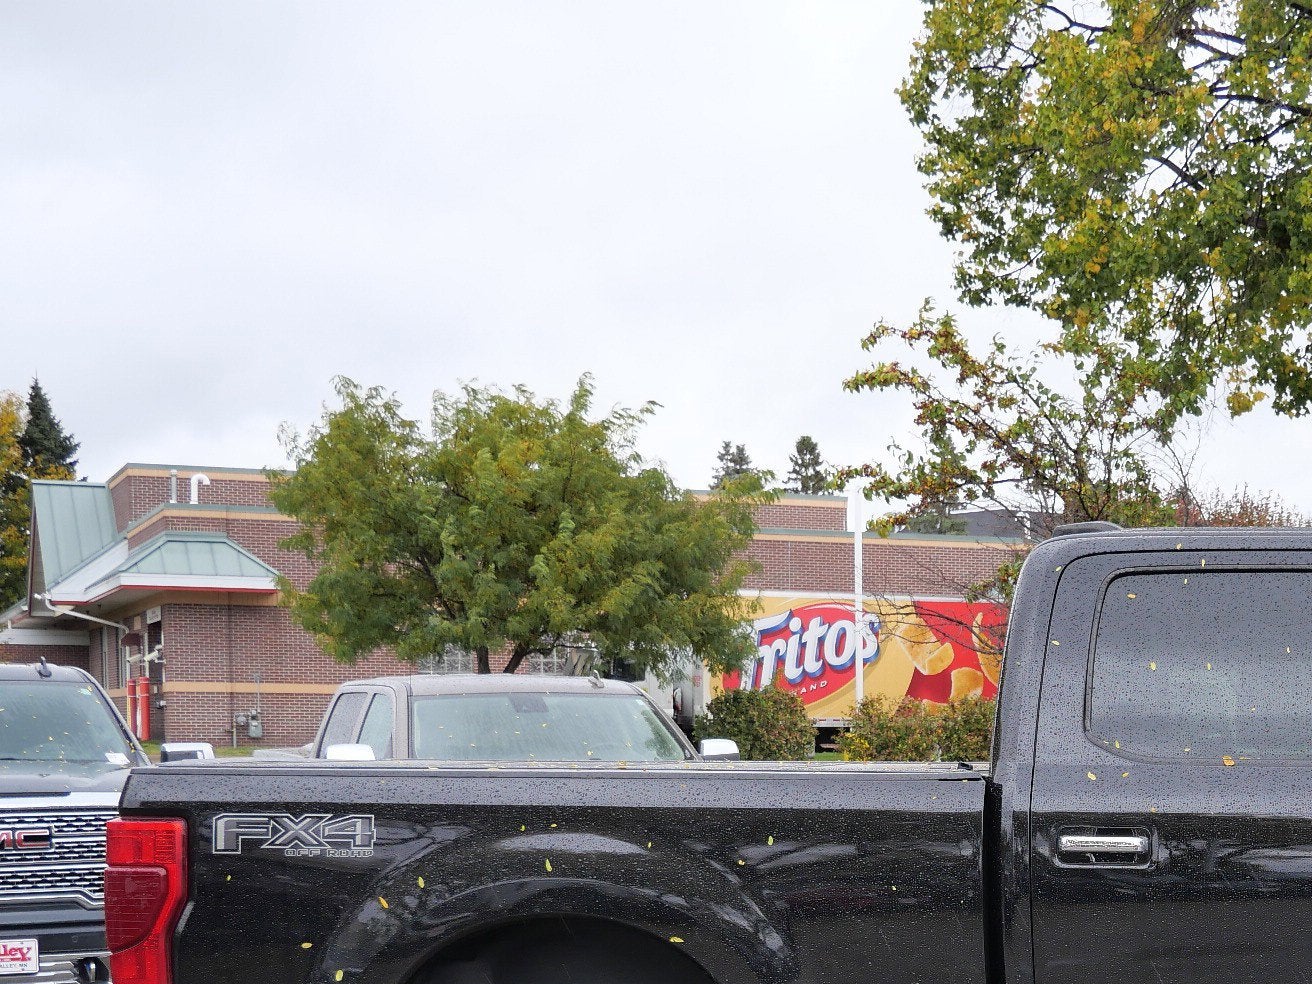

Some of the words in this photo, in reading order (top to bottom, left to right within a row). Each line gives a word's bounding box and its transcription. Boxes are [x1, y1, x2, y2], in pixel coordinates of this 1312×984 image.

[212, 813, 377, 854] FX4
[284, 848, 321, 858] OFF
[326, 849, 374, 858] ROAD
